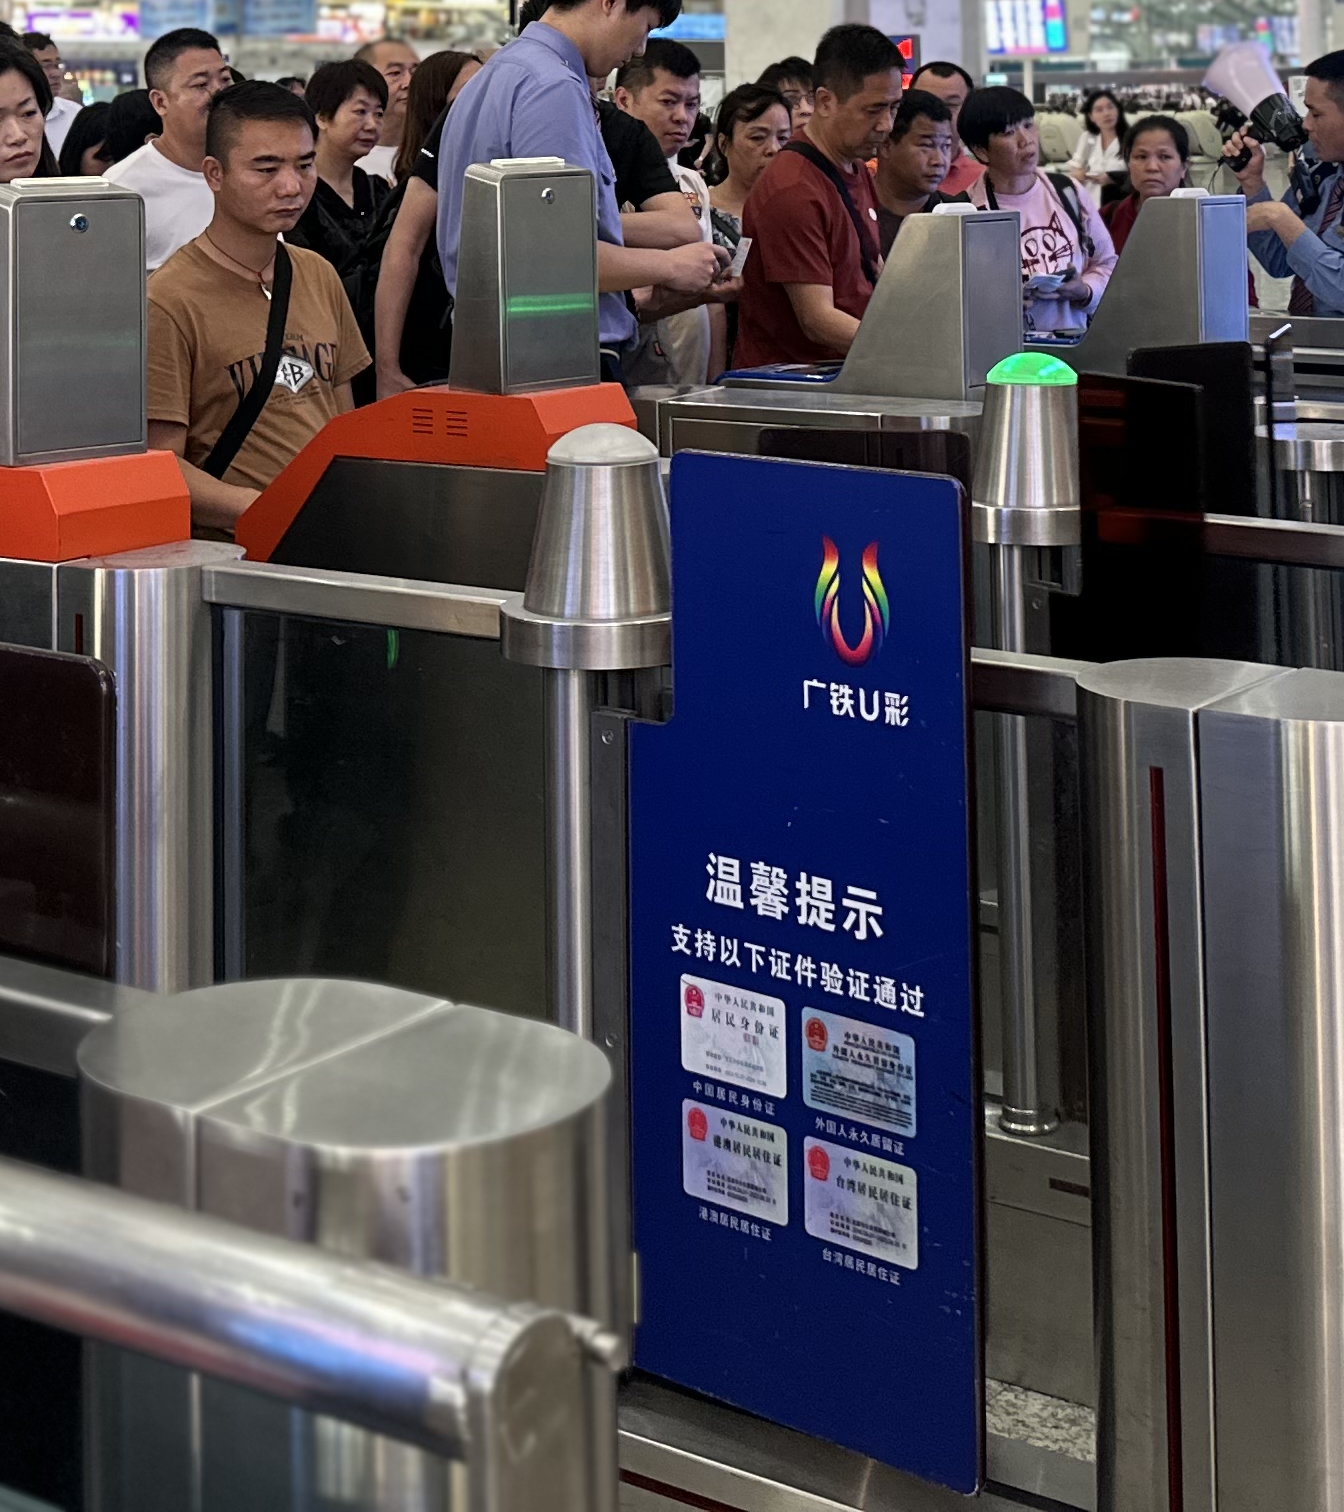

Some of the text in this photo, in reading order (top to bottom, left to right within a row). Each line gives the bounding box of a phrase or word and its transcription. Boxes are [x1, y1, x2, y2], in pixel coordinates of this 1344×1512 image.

[802, 679, 910, 728] 广铁U彩
[705, 852, 886, 941] 温馨提示
[671, 923, 925, 1018] 支持以下证件验证通过
[714, 992, 775, 1018] 中华人民共和国
[711, 1008, 780, 1040] 居民身份证
[692, 1080, 776, 1117] 中国居民身份证
[720, 1117, 776, 1143] 中华人民共和国
[815, 1116, 905, 1156] 外国人永久居留证
[843, 1157, 904, 1186] 中华人民共和国
[835, 1175, 913, 1211] 台湾居民居住证
[698, 1206, 772, 1242] 港澳居民居住证
[822, 1247, 901, 1286] 台湾居民居住证
